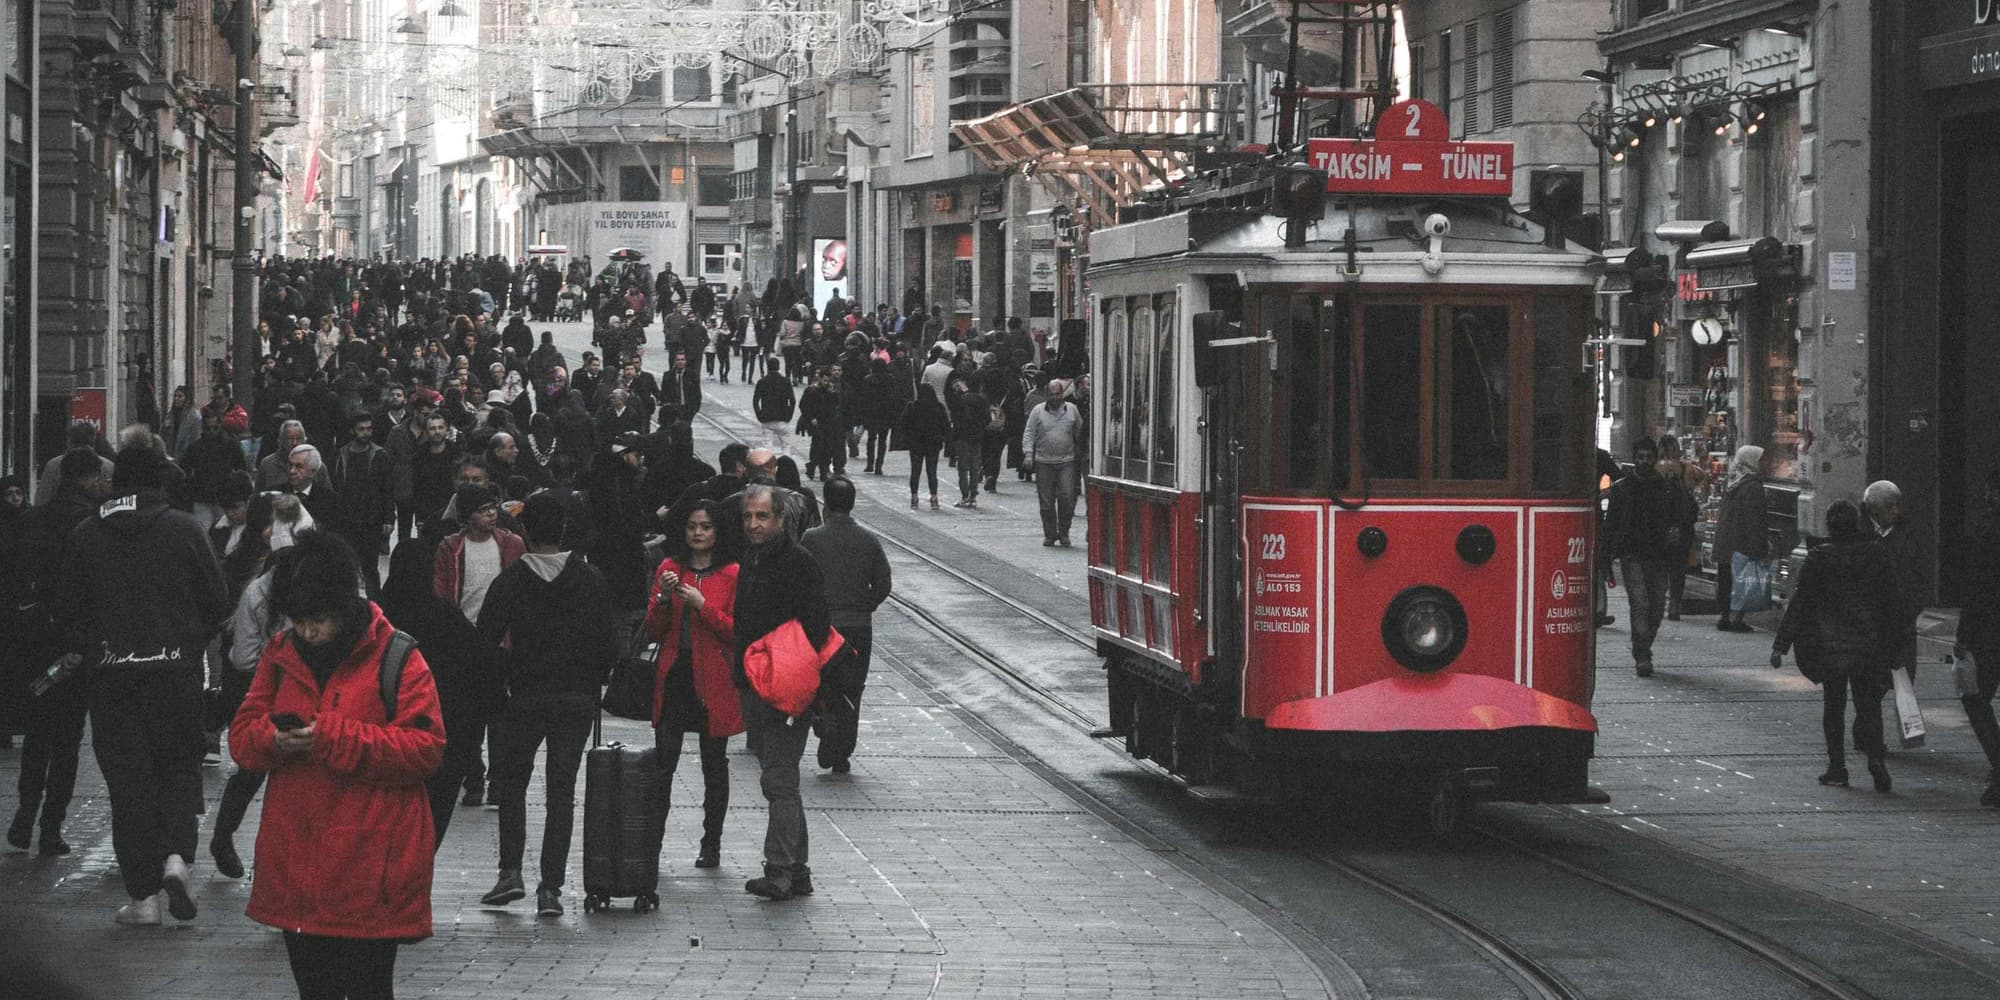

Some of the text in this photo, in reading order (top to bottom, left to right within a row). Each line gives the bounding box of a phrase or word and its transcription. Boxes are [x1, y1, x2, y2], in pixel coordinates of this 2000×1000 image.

[1405, 104, 1421, 137] 2
[1316, 147, 1391, 180] TAKSİM
[1441, 146, 1506, 180] TÜNEL
[600, 211, 670, 219] YIL BOYU SANAT
[595, 221, 608, 229] YIL
[611, 221, 633, 229] BOYU
[1262, 534, 1286, 560] 223
[1267, 583, 1301, 592] ALO 153
[1282, 607, 1308, 618] YASAK
[1545, 624, 1556, 634] VE
